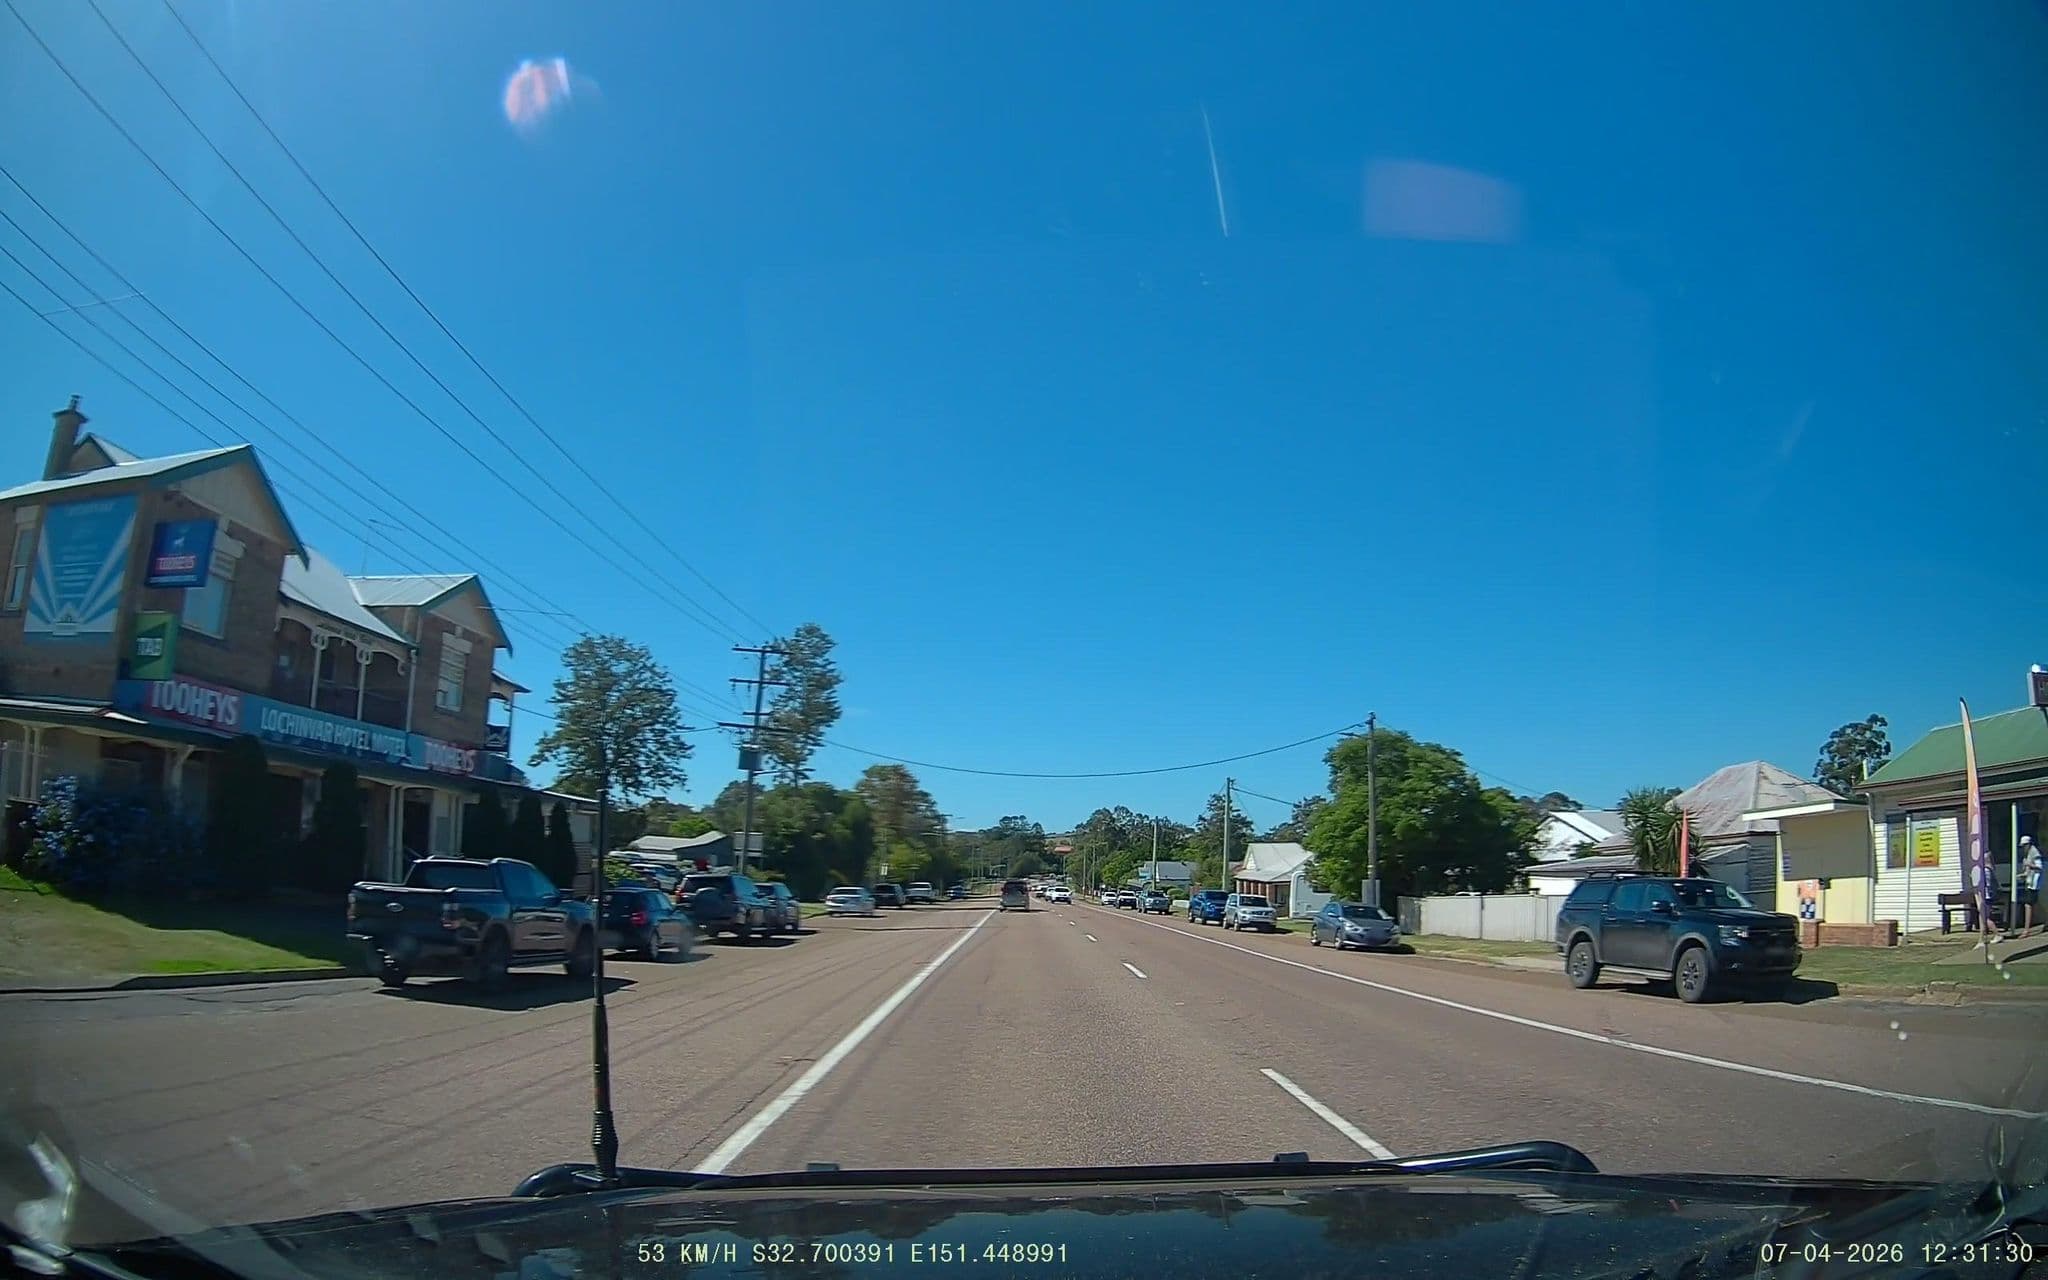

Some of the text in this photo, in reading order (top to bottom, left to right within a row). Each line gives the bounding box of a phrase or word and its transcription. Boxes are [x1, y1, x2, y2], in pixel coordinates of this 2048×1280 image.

[151, 680, 240, 726] TOOHEYS
[261, 707, 335, 743] LOCHINVAR
[334, 724, 371, 751] HOTEL
